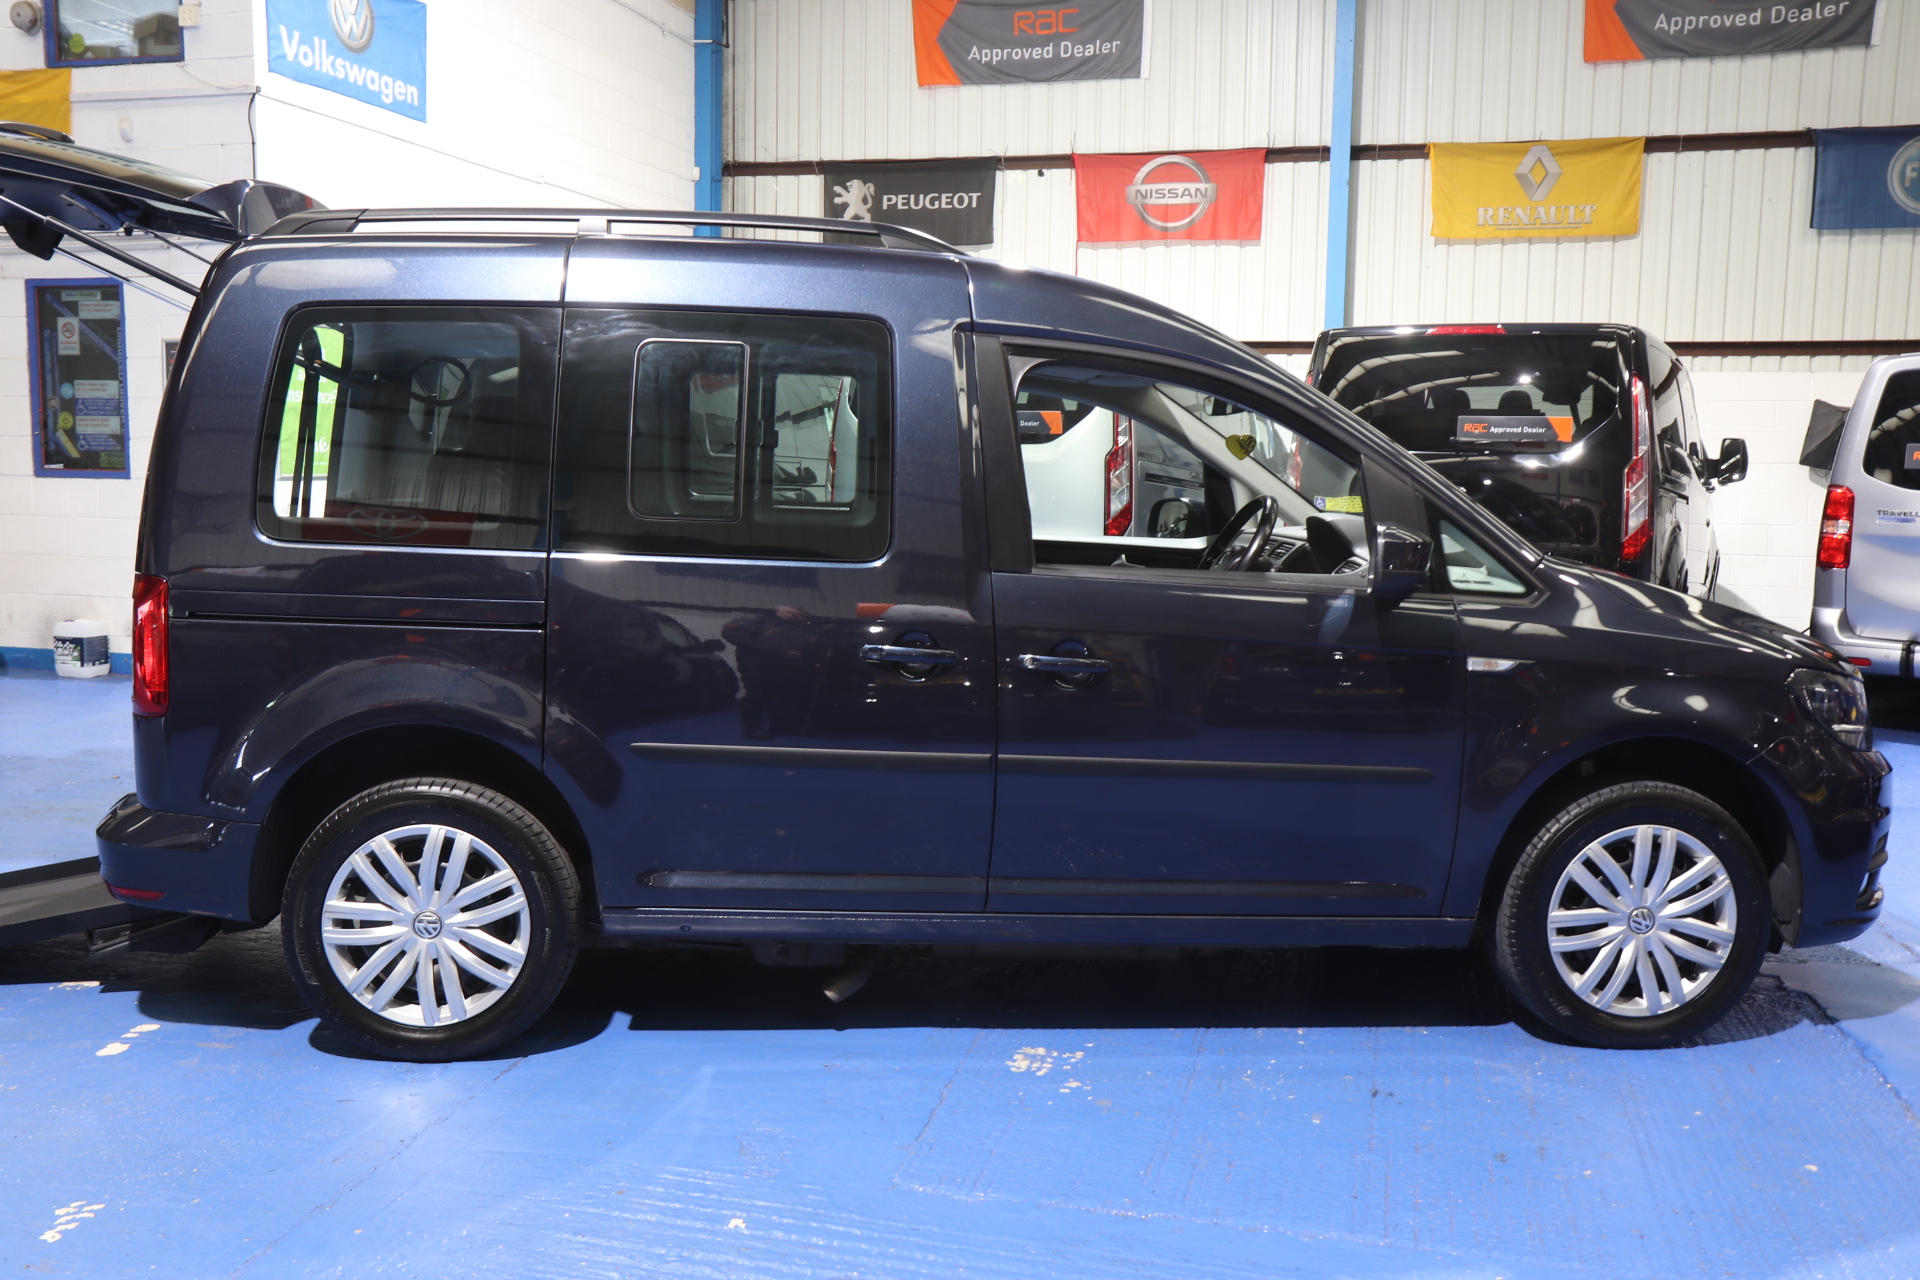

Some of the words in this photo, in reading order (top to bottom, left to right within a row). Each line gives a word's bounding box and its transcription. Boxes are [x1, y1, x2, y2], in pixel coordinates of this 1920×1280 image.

[1654, 8, 1762, 35] Approved
[1770, 0, 1850, 24] Dealer
[968, 42, 1053, 65] Approved
[1060, 39, 1121, 58] Dealer
[279, 24, 419, 106] Volkswagen
[882, 192, 981, 210] PEUGEOT
[1134, 187, 1208, 200] NISSAN
[1476, 204, 1597, 226] RENAULT
[1877, 509, 1920, 517] TRAVELL
